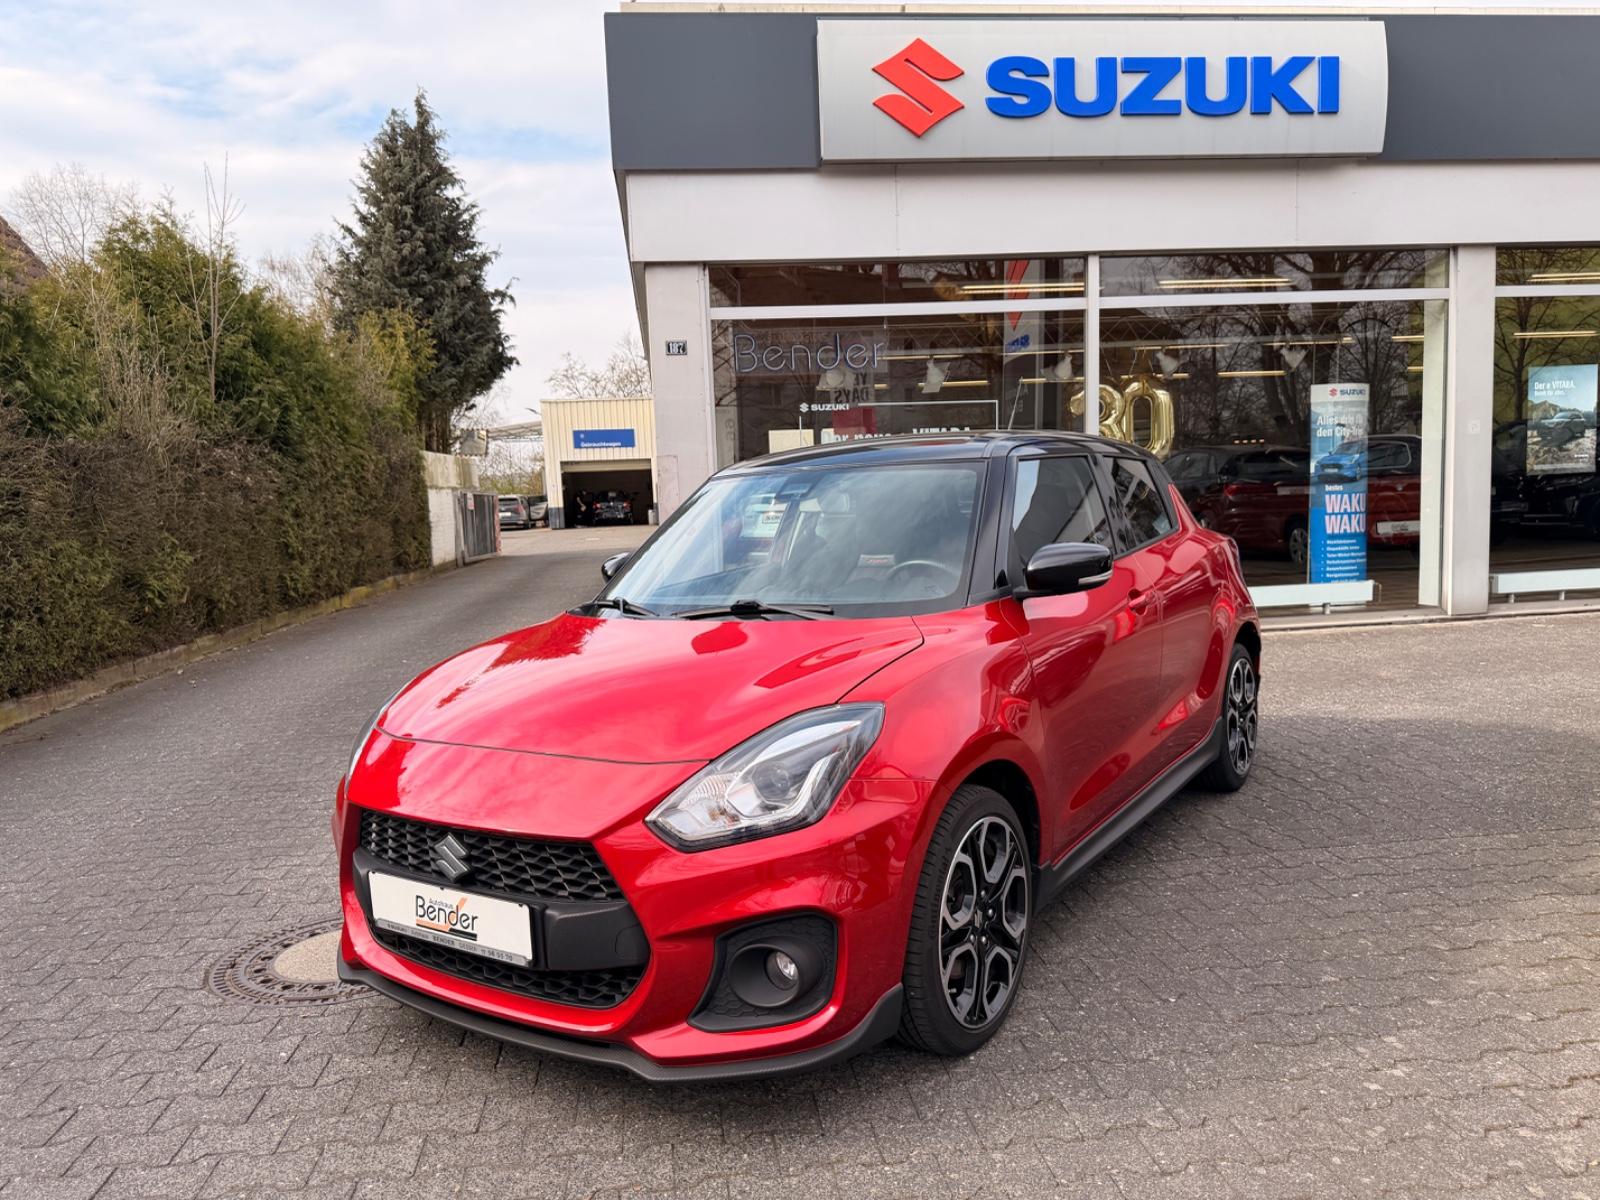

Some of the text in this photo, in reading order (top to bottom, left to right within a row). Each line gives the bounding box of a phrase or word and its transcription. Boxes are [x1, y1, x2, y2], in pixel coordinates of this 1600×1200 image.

[985, 55, 1340, 119] SUZUKI
[734, 331, 886, 374] Bender
[810, 403, 850, 412] SUZUKI
[1316, 427, 1334, 438] den
[1324, 493, 1367, 514] WAKU
[1324, 513, 1367, 535] WAKU
[415, 894, 479, 931] Bender
